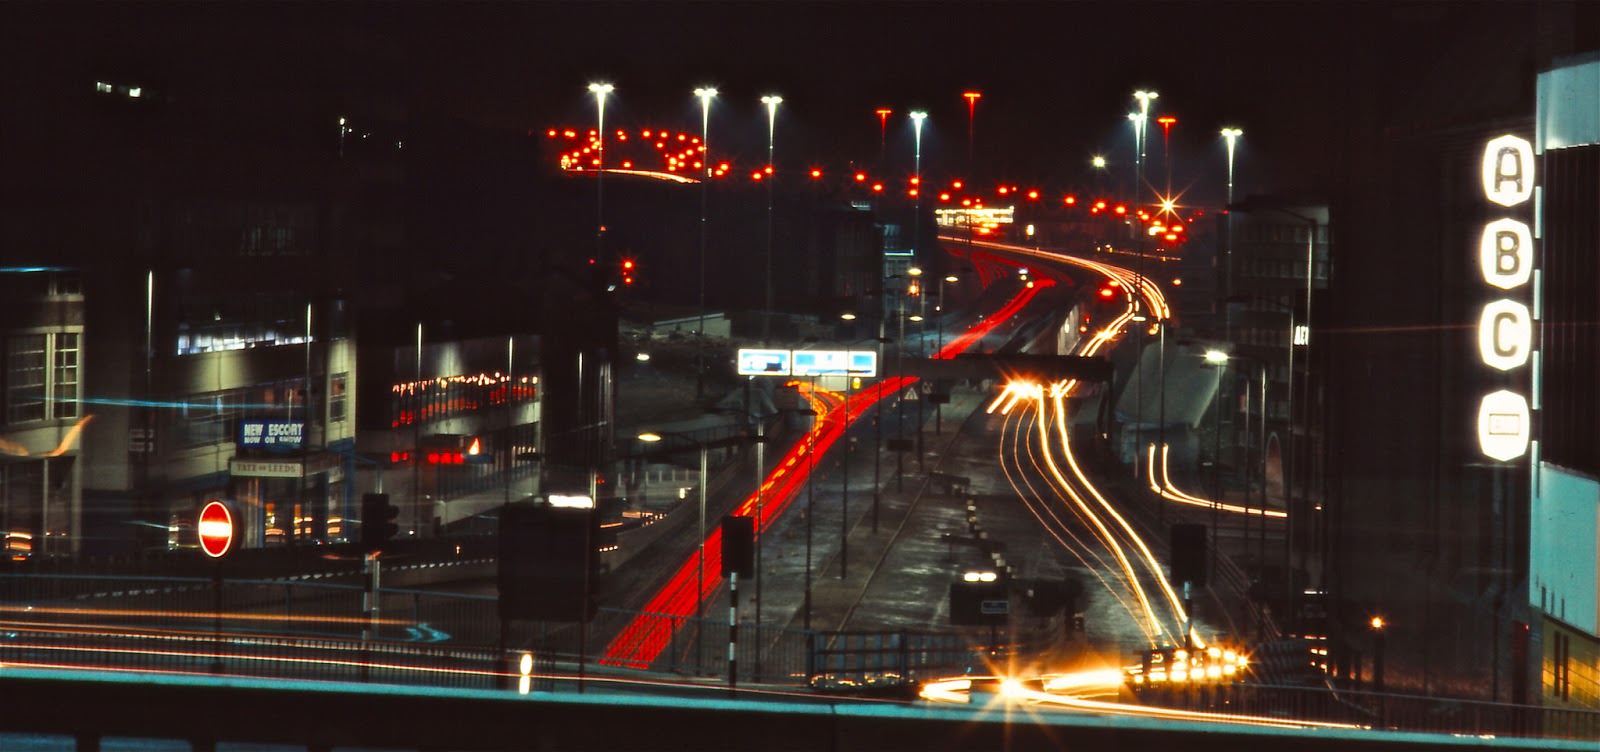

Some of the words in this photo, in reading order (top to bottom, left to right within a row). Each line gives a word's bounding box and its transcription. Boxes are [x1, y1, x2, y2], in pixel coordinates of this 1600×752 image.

[244, 423, 264, 436] NEW
[268, 423, 304, 436] ESCORT
[268, 464, 296, 472] LEEDS
